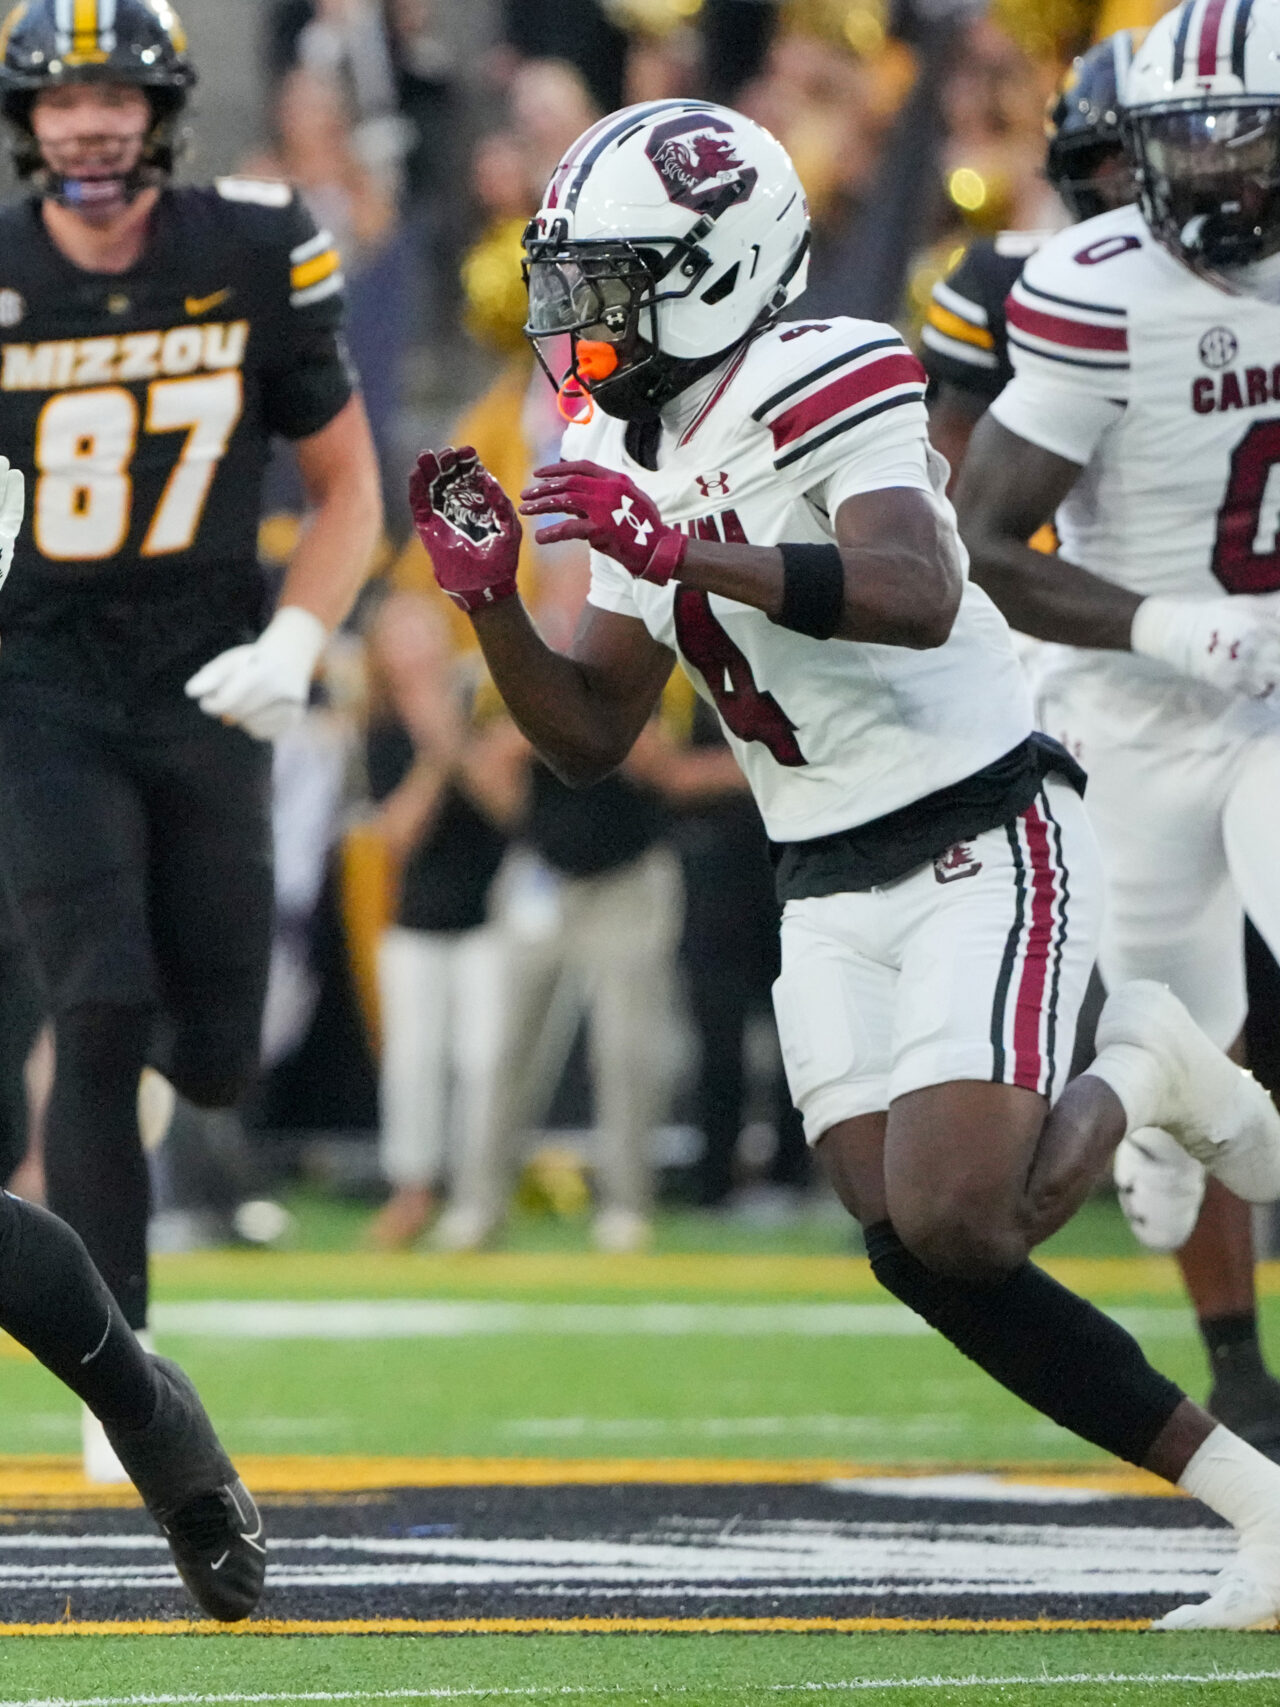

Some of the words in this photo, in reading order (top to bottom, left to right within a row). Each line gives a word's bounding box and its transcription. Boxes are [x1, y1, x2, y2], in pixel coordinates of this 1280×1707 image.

[0, 319, 250, 391] MIZZOU
[34, 369, 244, 562] 87
[672, 581, 809, 767] 4
